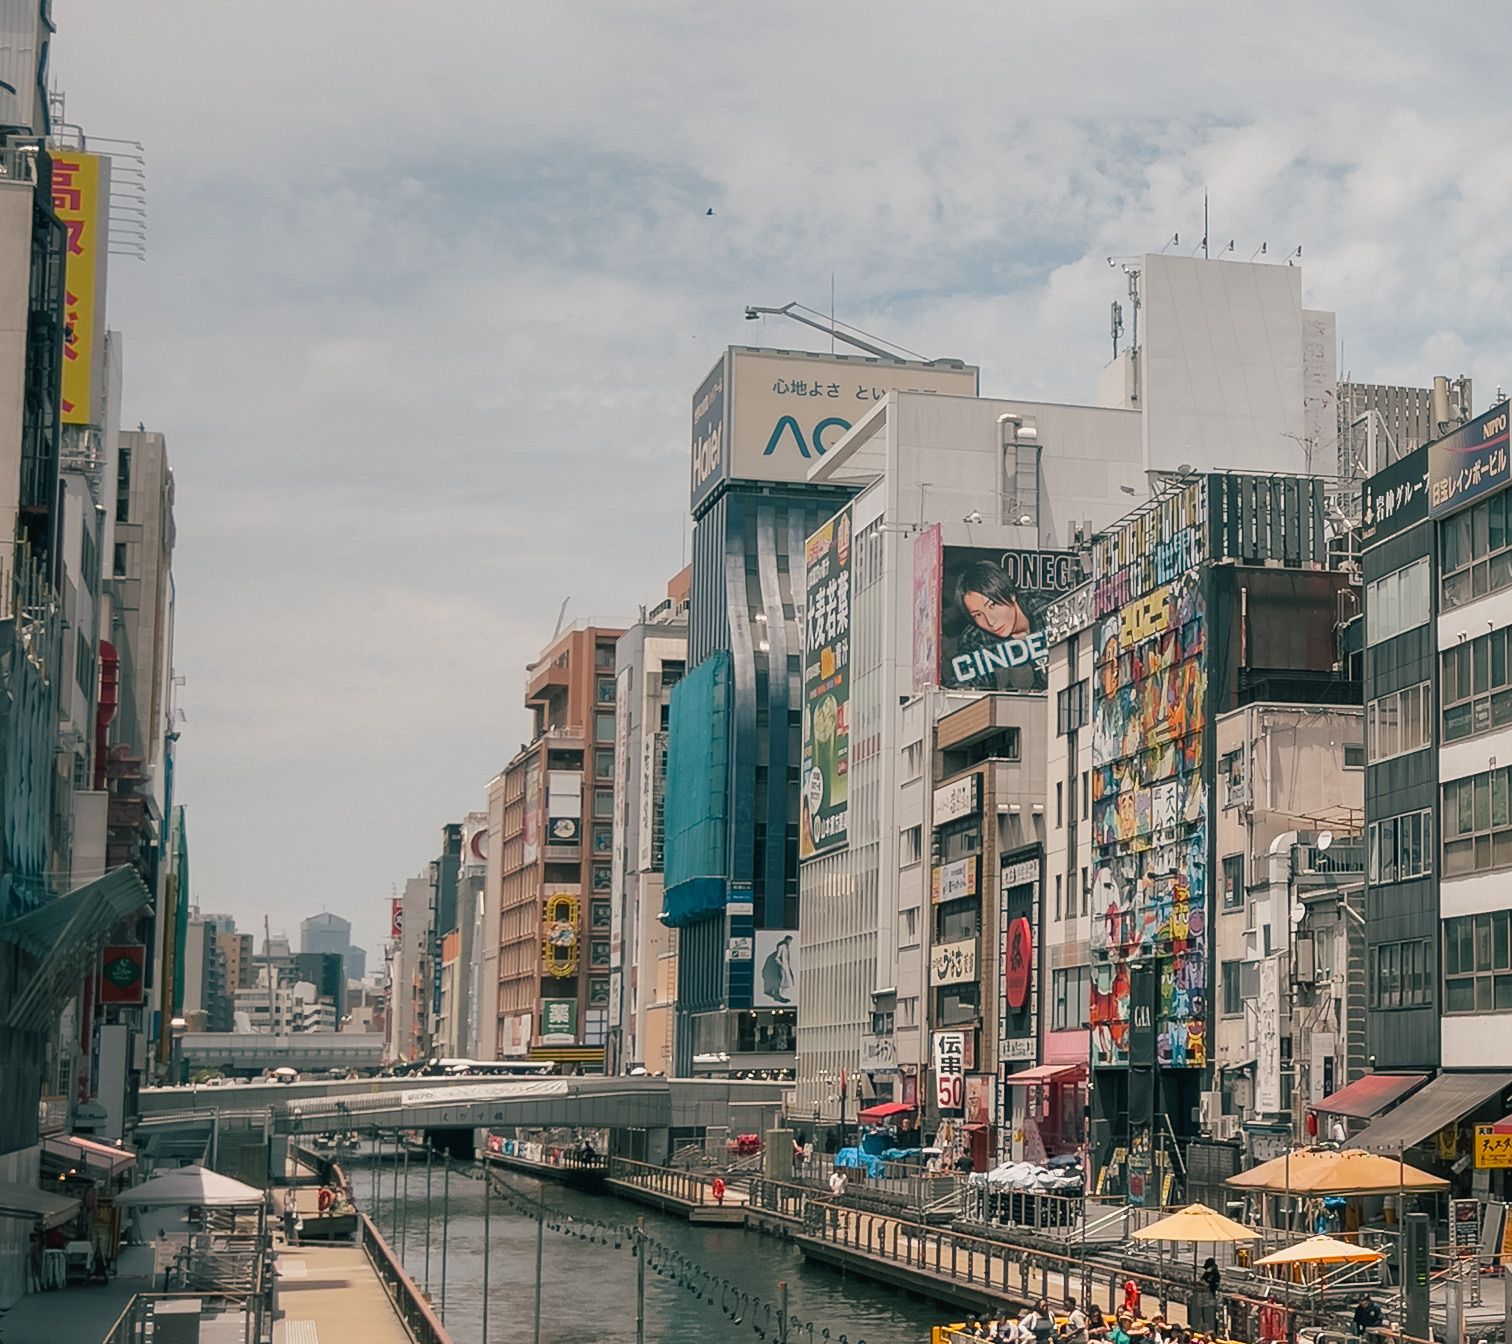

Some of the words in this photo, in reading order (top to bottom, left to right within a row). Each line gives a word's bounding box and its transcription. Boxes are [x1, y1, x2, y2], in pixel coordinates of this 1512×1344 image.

[772, 378, 841, 399] 心地よさ
[938, 1077, 963, 1107] 50
